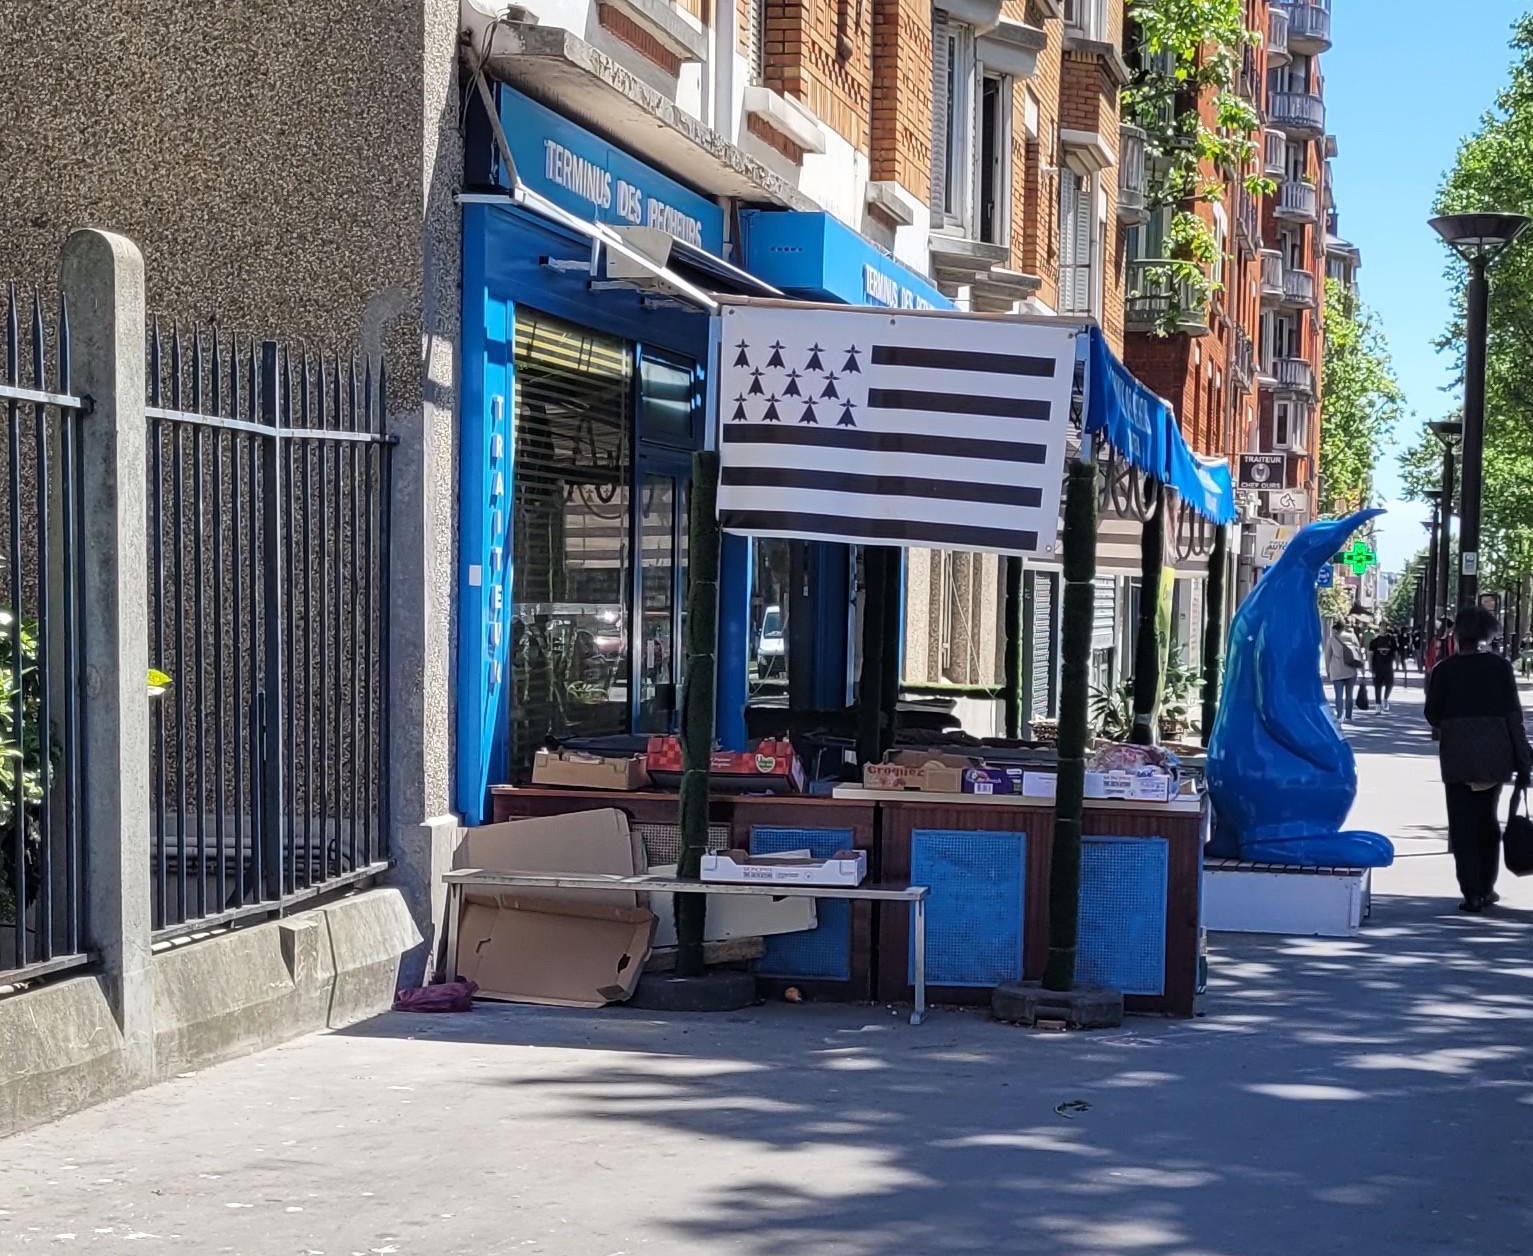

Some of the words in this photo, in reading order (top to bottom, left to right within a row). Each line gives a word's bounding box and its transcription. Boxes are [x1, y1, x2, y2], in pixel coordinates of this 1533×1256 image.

[544, 139, 611, 208] TERMINUS
[616, 180, 642, 224] DES
[864, 263, 898, 308] TERMINUS
[1244, 455, 1282, 463] TRAITEUR
[868, 765, 925, 777] Croquez
